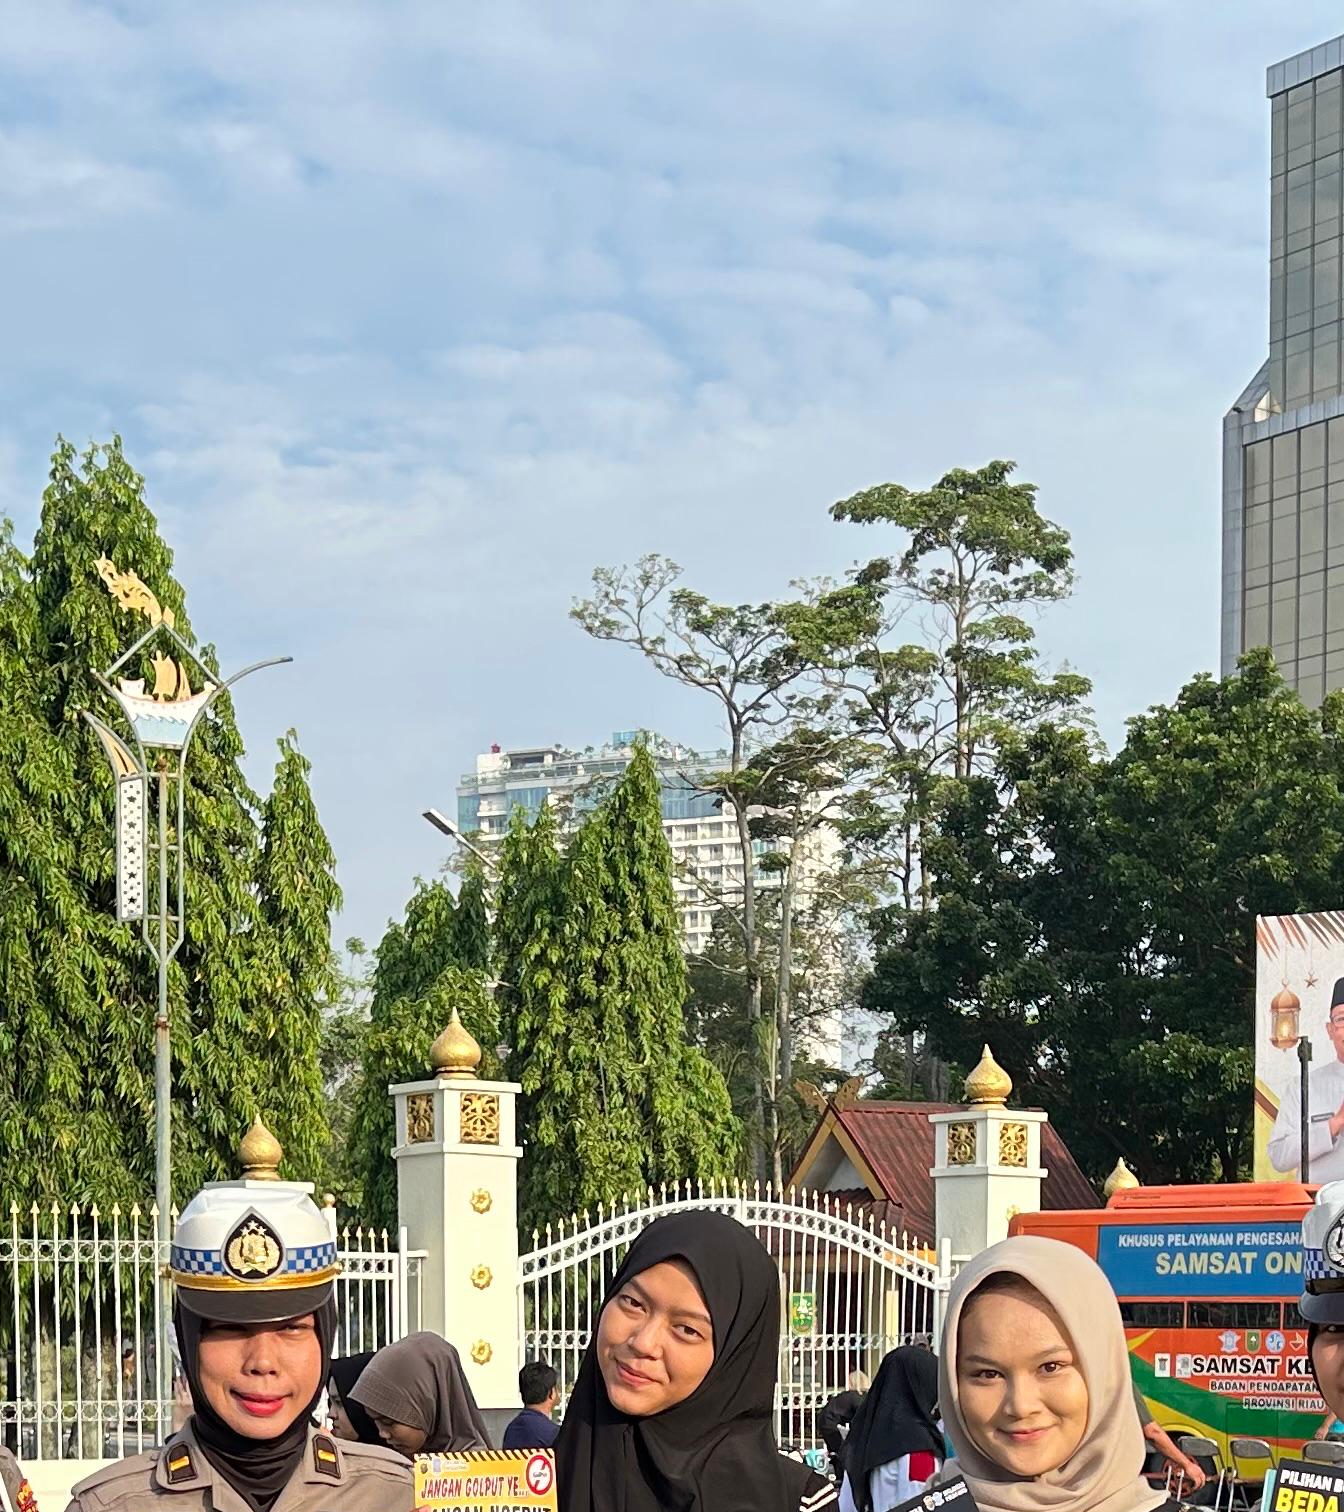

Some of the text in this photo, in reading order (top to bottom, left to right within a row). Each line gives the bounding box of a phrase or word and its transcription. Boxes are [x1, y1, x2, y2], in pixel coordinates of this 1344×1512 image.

[1118, 1233, 1165, 1248] KHUSUS
[1167, 1232, 1234, 1247] PELAYANAN
[1156, 1251, 1258, 1275] SAMSAT
[1192, 1357, 1281, 1374] SAMSAT
[1210, 1381, 1246, 1392] BADAN
[1243, 1398, 1325, 1410] PROVINSI RIAU
[421, 1477, 461, 1499] JANGAN
[465, 1476, 505, 1498] GOLPUT
[1280, 1469, 1332, 1493] PILIHAN
